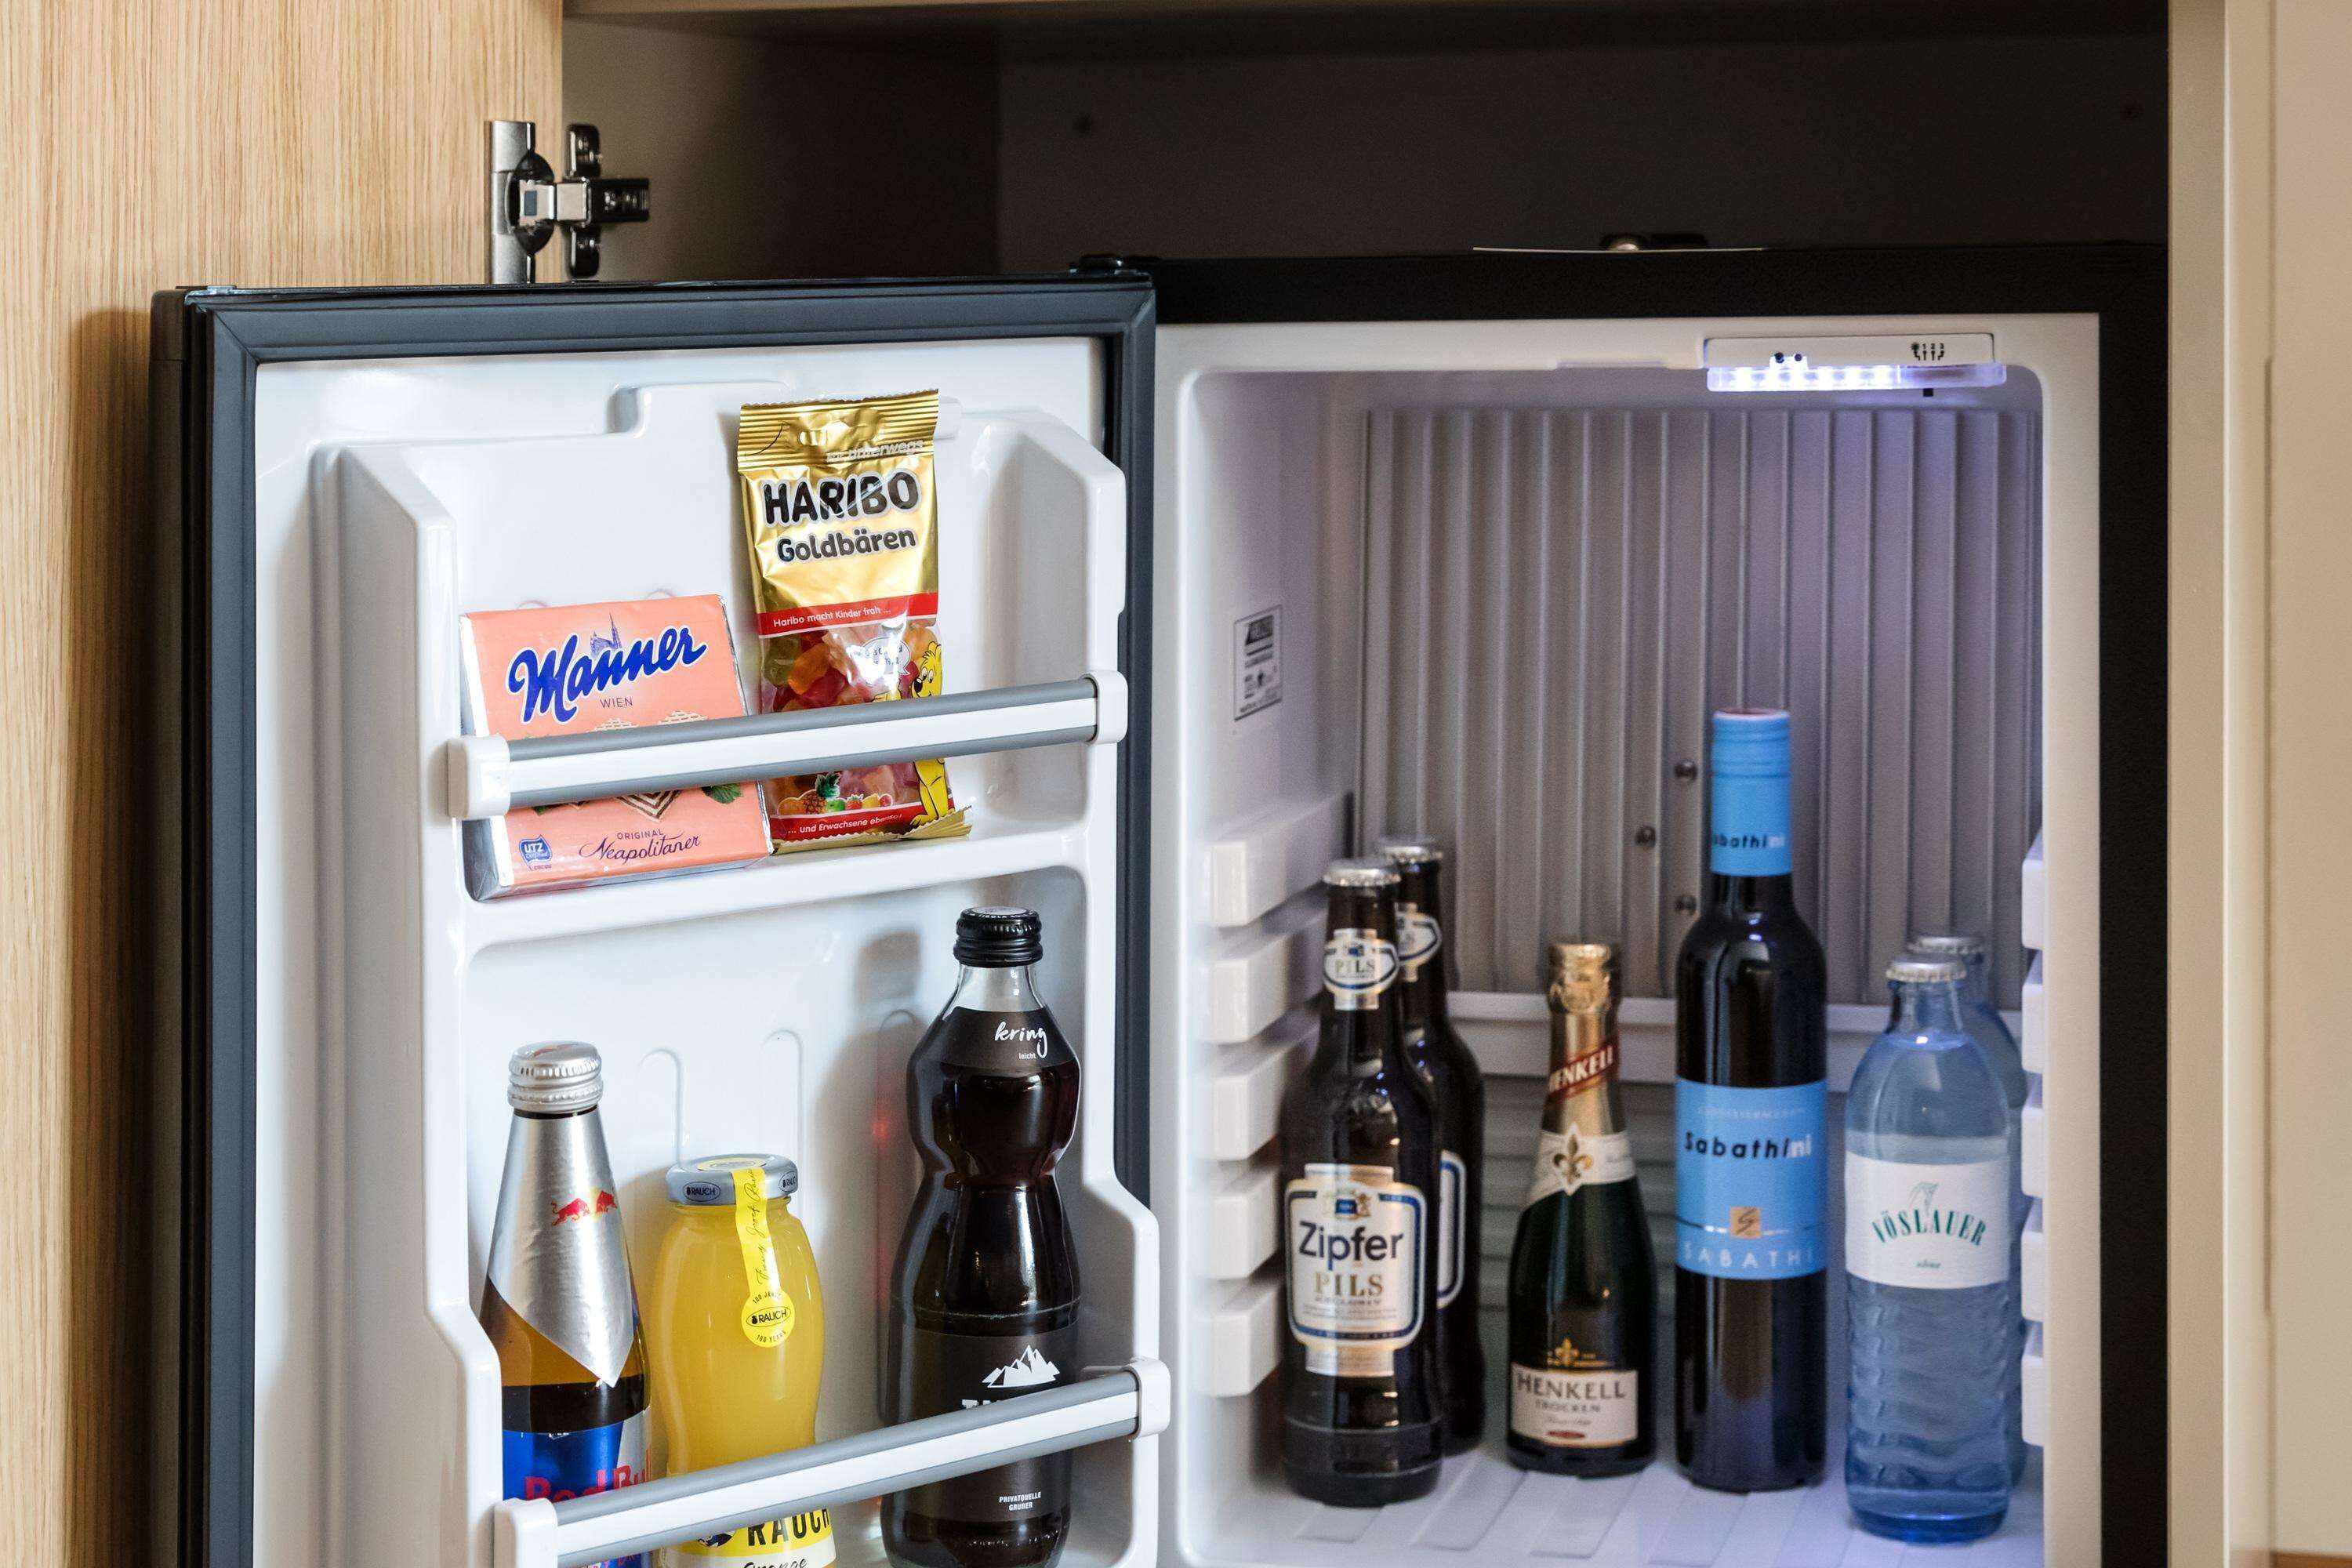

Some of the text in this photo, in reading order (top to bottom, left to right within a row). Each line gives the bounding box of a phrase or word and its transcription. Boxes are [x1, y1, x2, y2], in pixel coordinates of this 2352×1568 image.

[763, 470, 920, 525] HARIBO
[777, 528, 916, 562] Goldbären
[773, 615, 804, 628] Haribo
[807, 612, 833, 622] macht
[835, 609, 862, 619] Kinder
[863, 606, 881, 615] froh
[508, 627, 707, 723] Manner
[600, 696, 633, 709] WIEN
[616, 828, 665, 840] ORIGINAL
[799, 824, 817, 833] und
[818, 818, 868, 832] Erwachsene
[524, 843, 544, 853] UTZ
[579, 831, 702, 866] Neapolitaner
[1335, 960, 1376, 973] PILS
[994, 1021, 1048, 1058] kring
[691, 1186, 717, 1196] RAUCH
[1298, 1220, 1404, 1271] Zipfer
[1315, 1272, 1384, 1297] PILS
[758, 1308, 787, 1323] RAUCH
[1516, 1372, 1627, 1400] HENKELL
[999, 1491, 1042, 1504] PRIVATQUELLE
[1008, 1501, 1033, 1512] GRUBER
